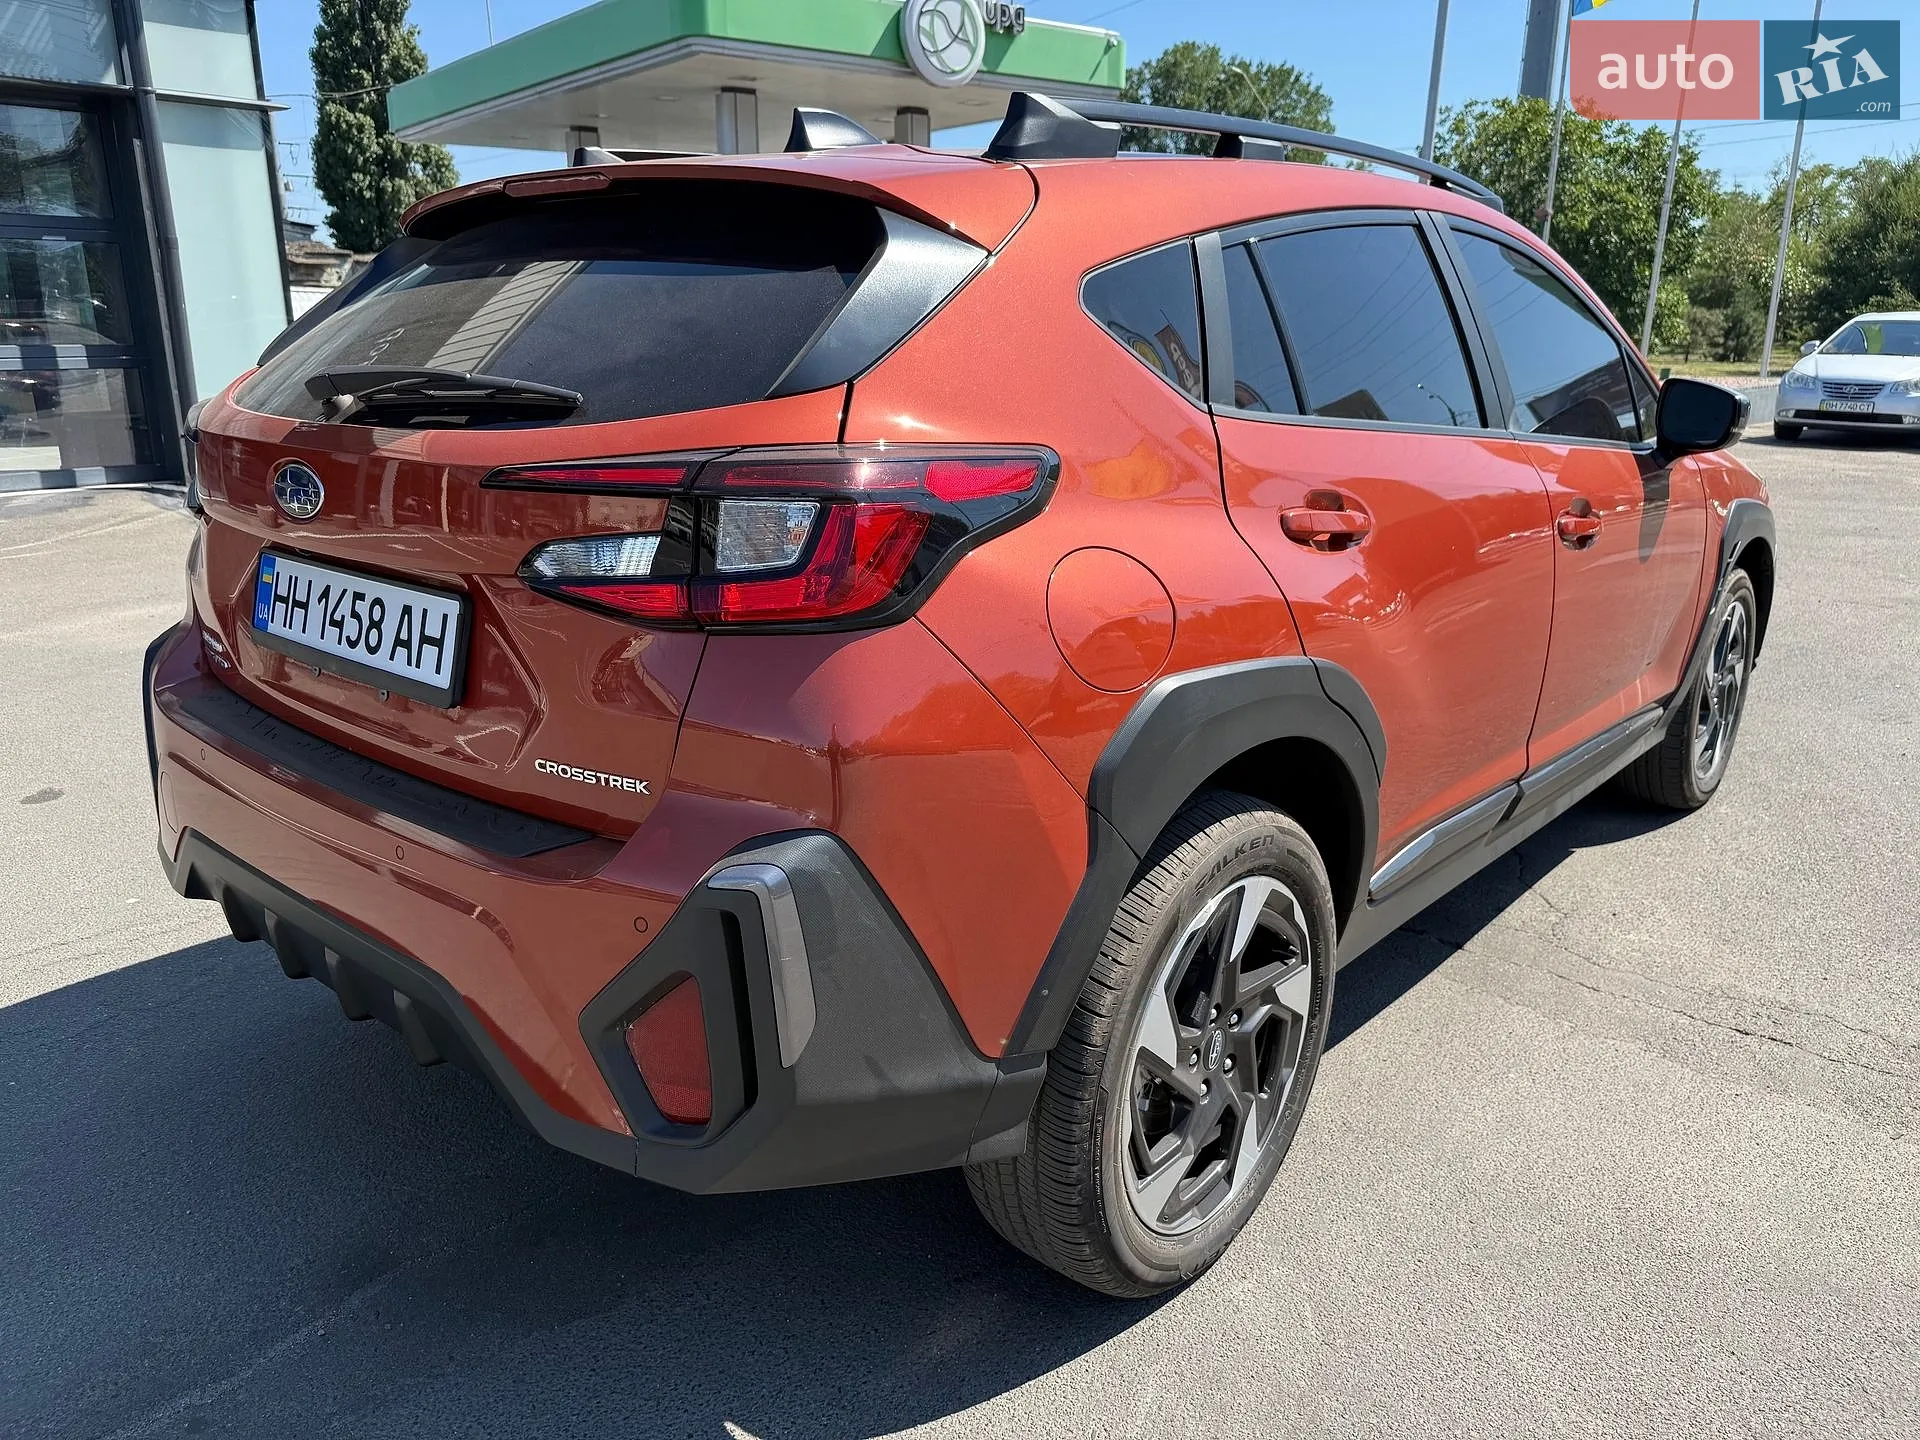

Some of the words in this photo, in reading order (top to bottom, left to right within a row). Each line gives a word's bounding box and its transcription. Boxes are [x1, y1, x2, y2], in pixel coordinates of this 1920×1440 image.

[985, 1, 1025, 34] upg
[258, 602, 269, 621] UA
[270, 571, 313, 635] HH
[317, 583, 386, 656] 1458
[388, 603, 449, 676] AH
[534, 758, 651, 795] CROSSTREK
